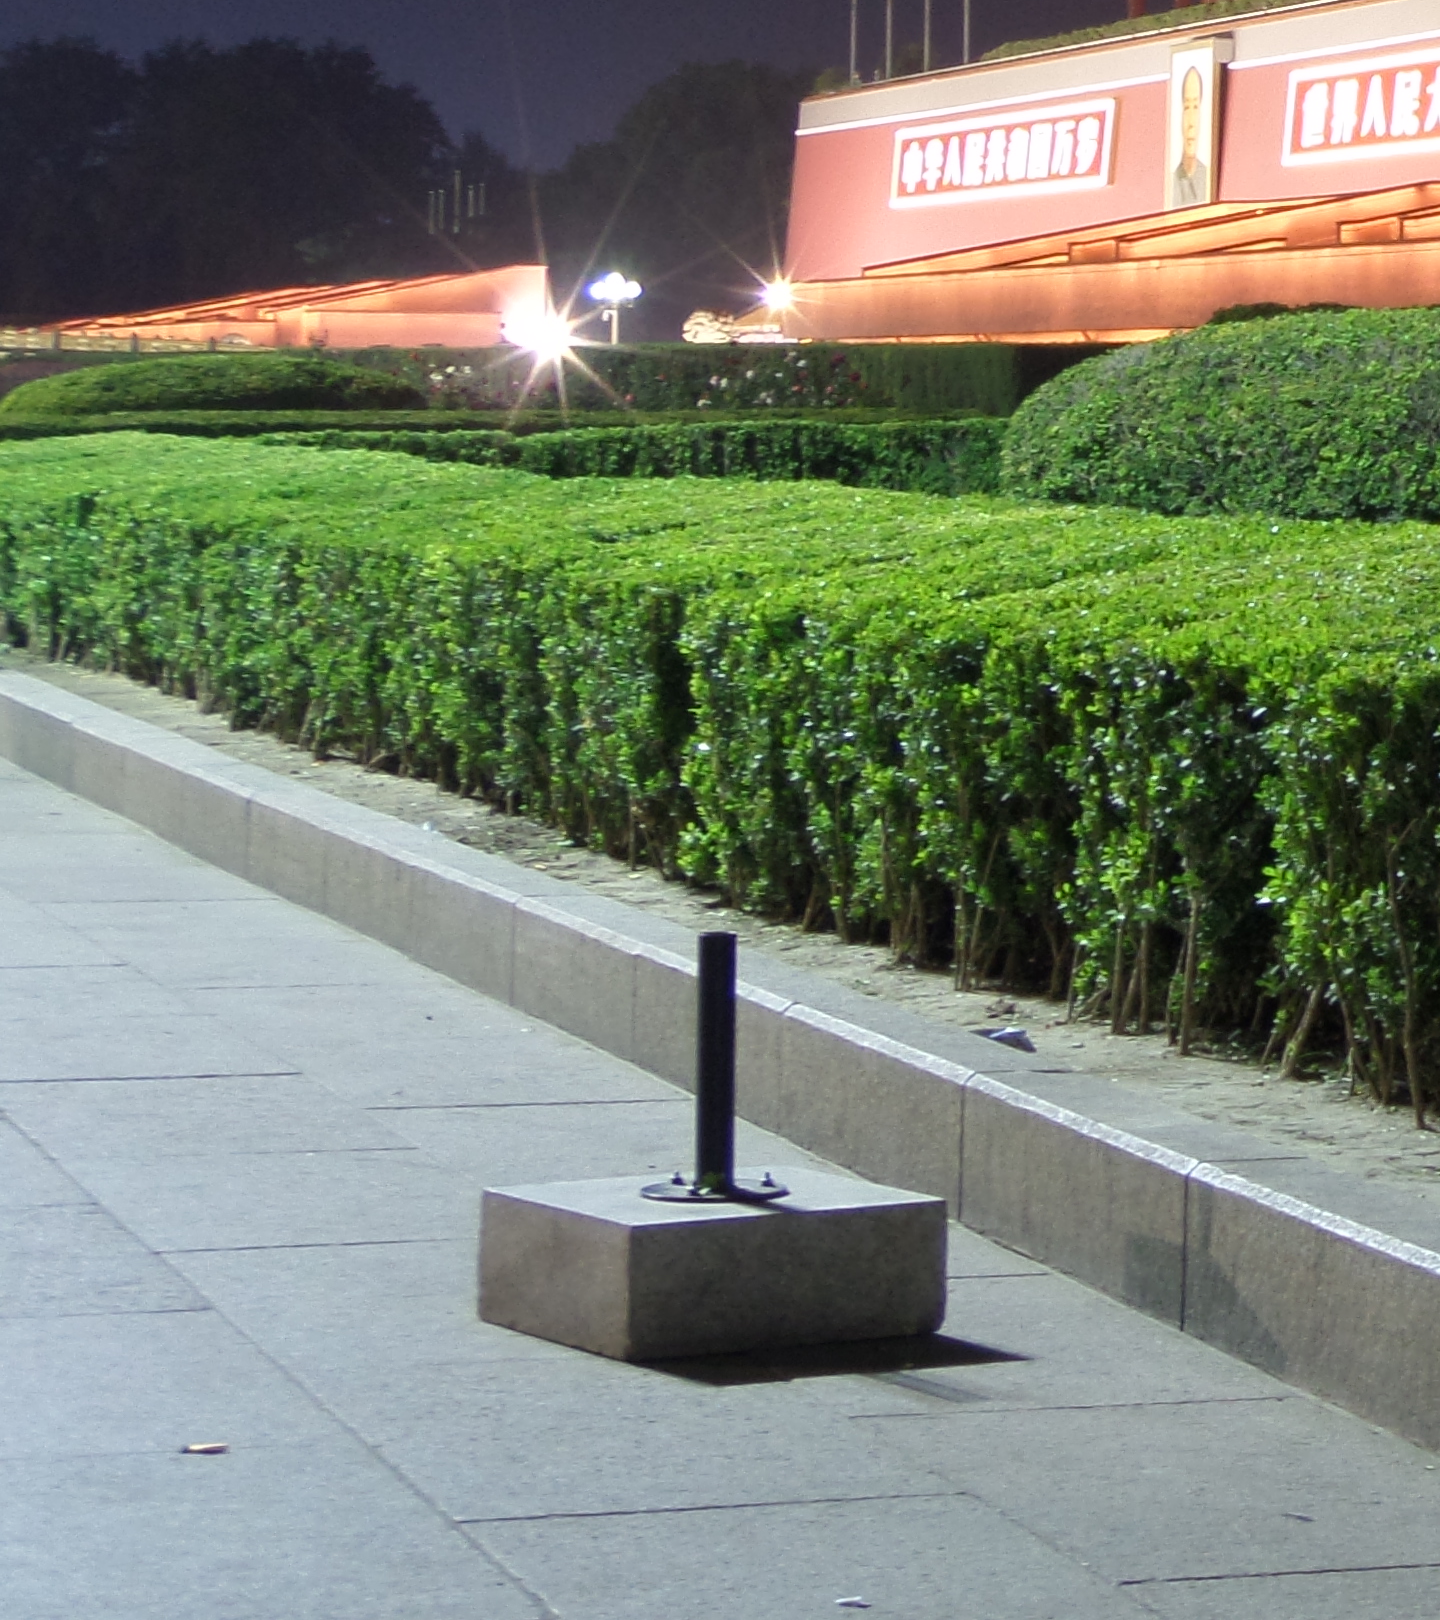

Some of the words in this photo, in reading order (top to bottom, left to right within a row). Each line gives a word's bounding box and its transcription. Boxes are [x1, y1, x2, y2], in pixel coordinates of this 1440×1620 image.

[901, 116, 1100, 194] 中华人民共万岁
